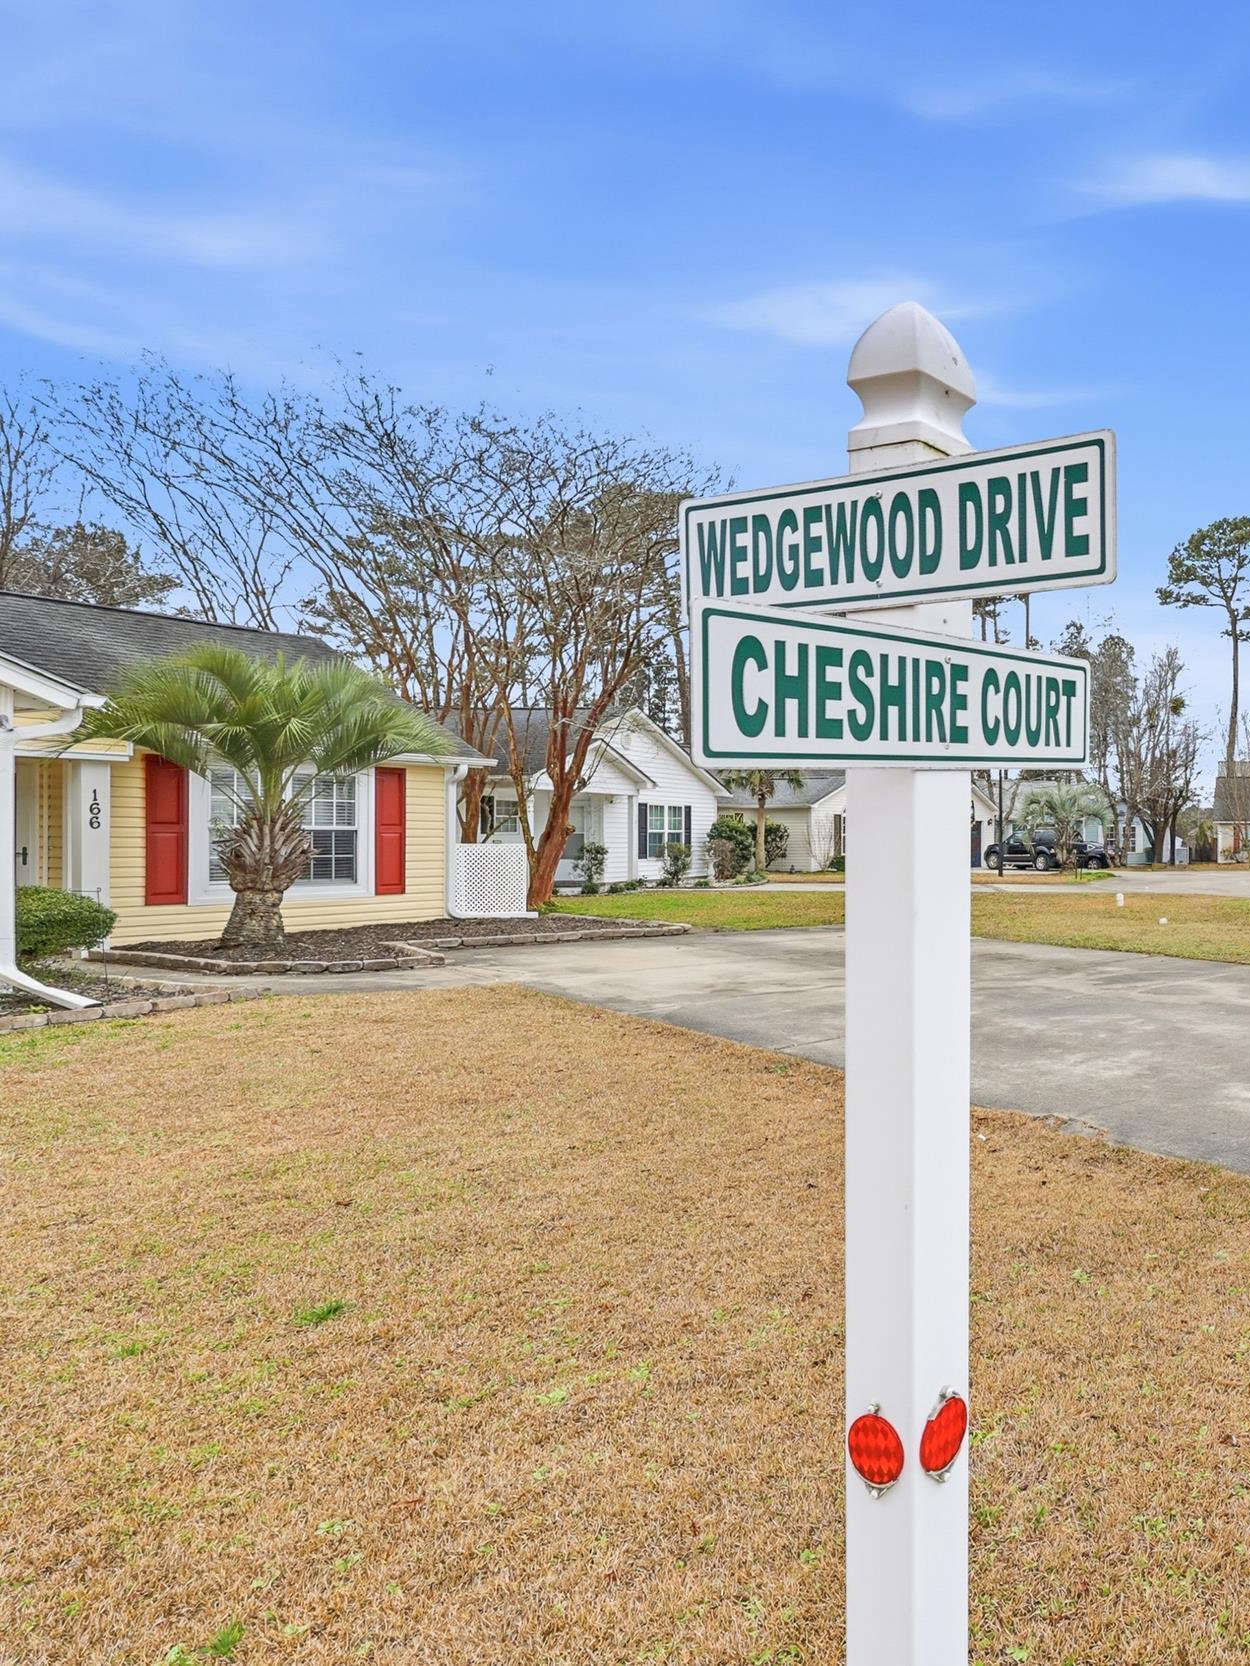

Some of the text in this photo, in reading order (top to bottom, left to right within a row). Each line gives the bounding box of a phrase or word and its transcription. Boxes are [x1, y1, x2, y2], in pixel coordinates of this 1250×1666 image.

[697, 462, 1090, 597] WEDGEWOOD DRIVE
[731, 635, 1076, 748] CHESHIRE COURT
[89, 788, 101, 829] 166
